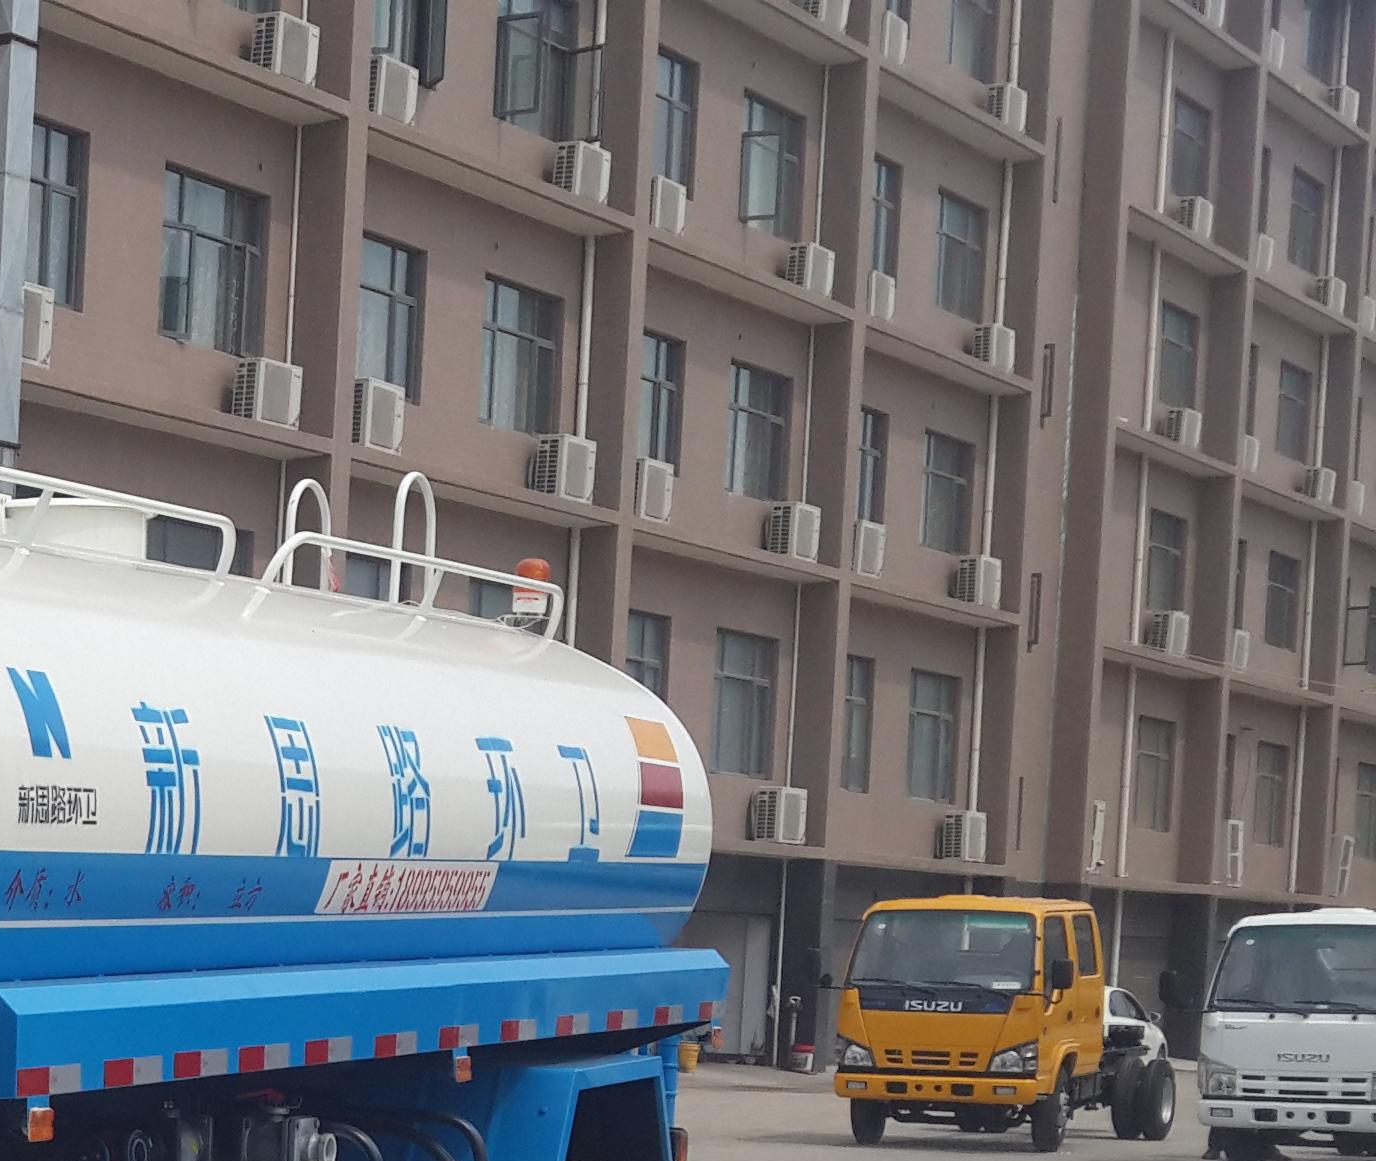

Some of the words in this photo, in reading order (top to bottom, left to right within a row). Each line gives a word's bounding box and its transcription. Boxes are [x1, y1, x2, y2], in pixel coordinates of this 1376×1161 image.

[18, 785, 97, 824] 新思路环卫
[905, 999, 963, 1012] ISUZU
[1276, 1053, 1331, 1063] ISUZU
